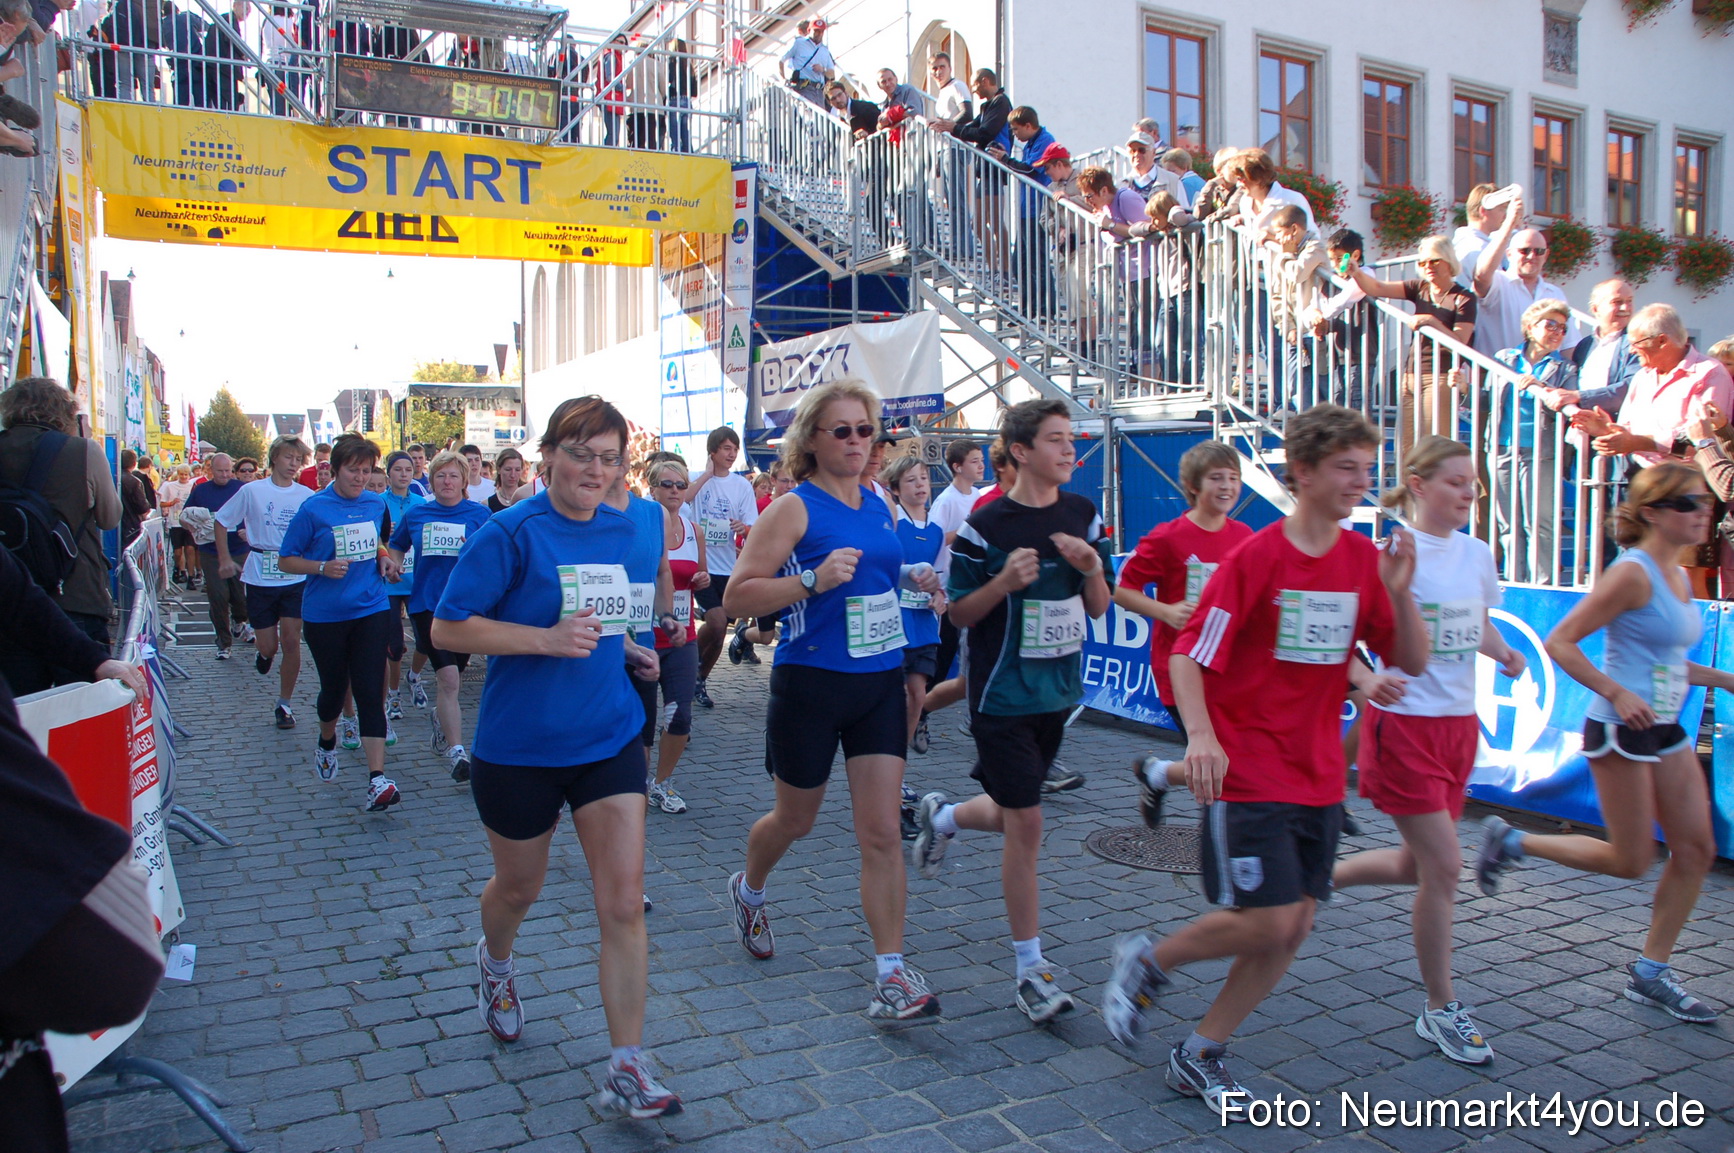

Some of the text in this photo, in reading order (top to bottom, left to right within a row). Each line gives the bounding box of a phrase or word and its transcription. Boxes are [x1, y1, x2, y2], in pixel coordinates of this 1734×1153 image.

[343, 58, 393, 72] SPORTRONIC
[410, 66, 460, 80] Elektronische
[133, 154, 287, 178] Neumarkter Stadtlauf
[327, 144, 542, 205] START
[580, 189, 700, 209] Neumarkter Stadtlauf
[135, 207, 267, 226] Neumarkter Stadtlauf
[523, 230, 582, 243] Neumarkter
[346, 528, 360, 536] Erna
[708, 531, 728, 540] 5025
[349, 538, 376, 552] 5114
[433, 536, 461, 547] 5097
[581, 570, 613, 585] Christa
[585, 596, 626, 617] 5089
